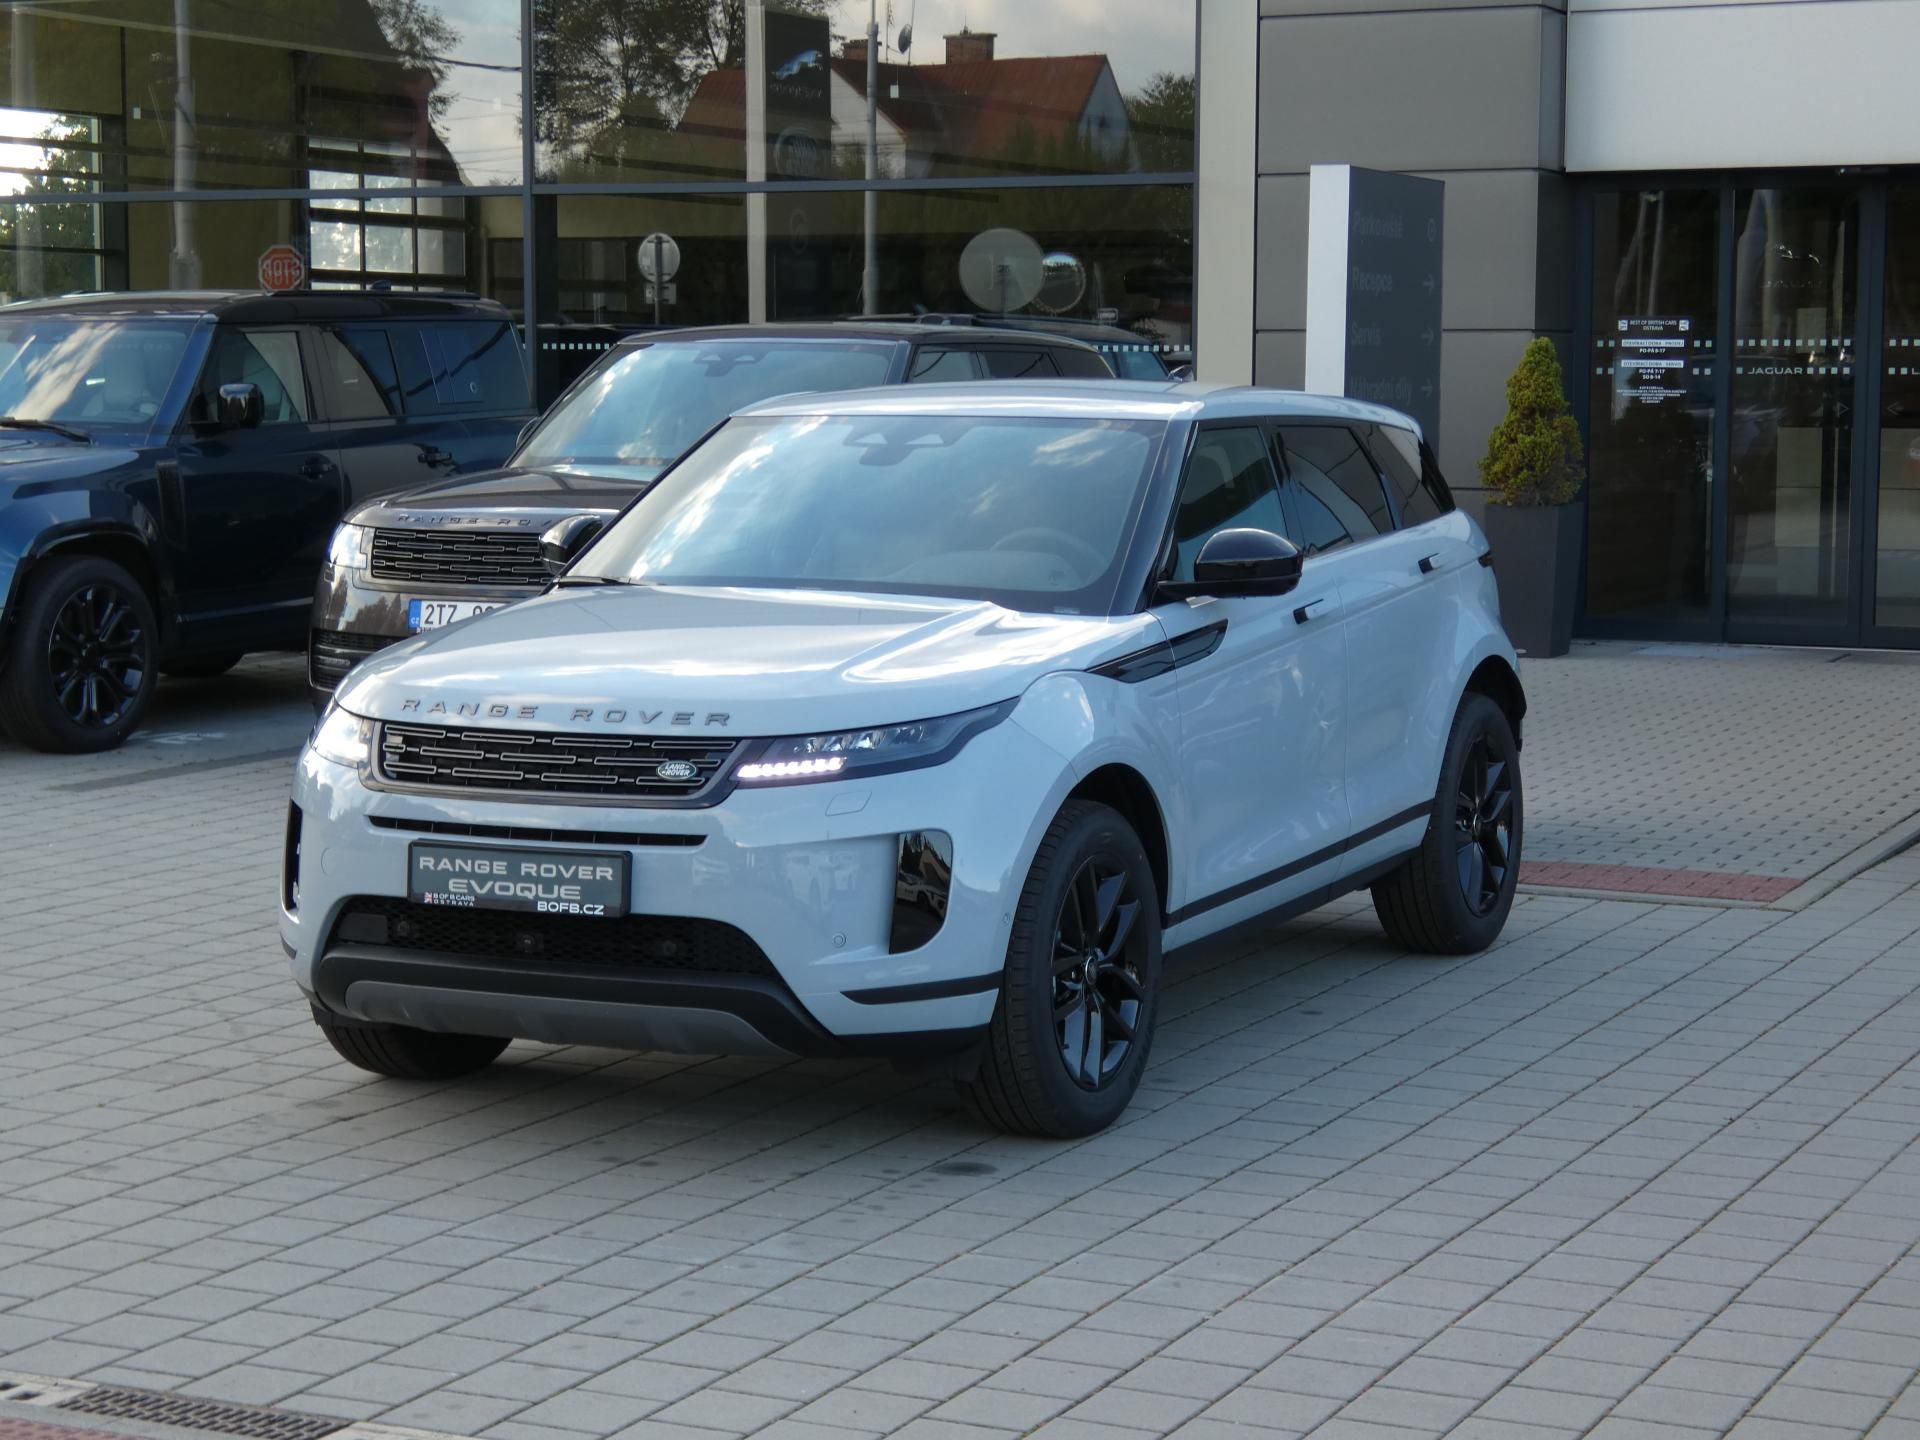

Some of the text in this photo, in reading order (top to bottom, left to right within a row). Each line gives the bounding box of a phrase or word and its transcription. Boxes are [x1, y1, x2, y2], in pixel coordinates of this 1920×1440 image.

[1747, 367, 1803, 375] JAGUAR
[400, 699, 730, 726] RANGE ROVER
[419, 856, 614, 881] RANGE ROVER
[448, 878, 581, 900] EVOQUE
[433, 898, 474, 907] OSTRAVA
[537, 901, 605, 915] BOFB.CZ
